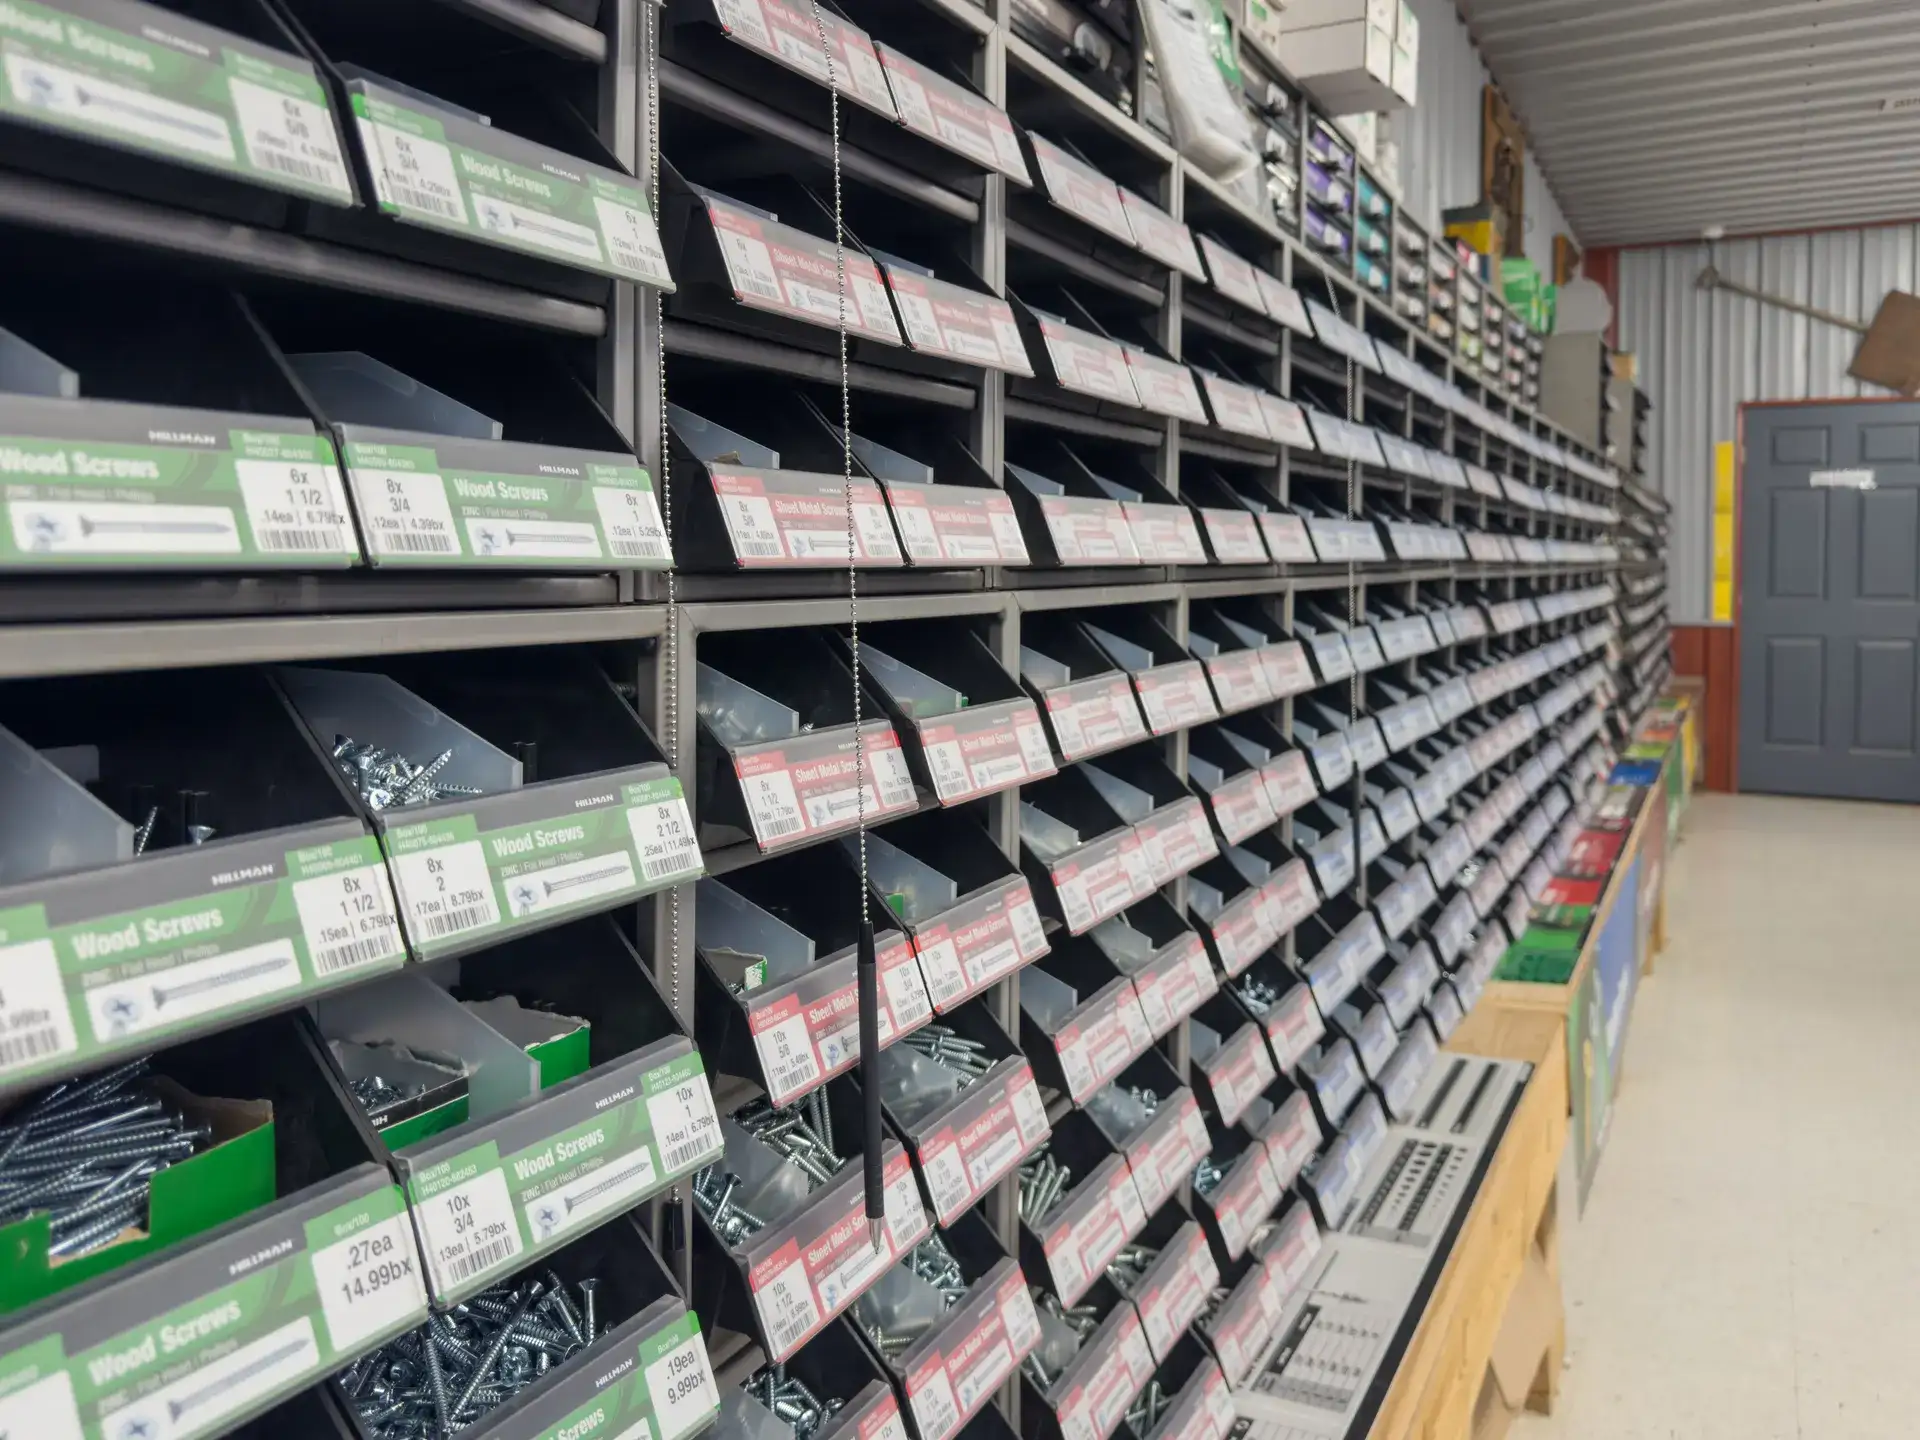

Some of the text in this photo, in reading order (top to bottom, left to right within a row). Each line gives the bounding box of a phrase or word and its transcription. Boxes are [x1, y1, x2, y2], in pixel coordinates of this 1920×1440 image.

[459, 153, 502, 182] Wood
[501, 168, 553, 198] Screws
[71, 449, 160, 481] Screws
[538, 463, 580, 477] HILLMAN
[385, 478, 404, 495] 8x
[453, 477, 550, 503] Wood Screws
[389, 496, 411, 513] 3/4
[625, 493, 639, 507] 8x
[818, 762, 841, 781] Metal
[574, 794, 615, 808] HILLMAN
[658, 807, 671, 820] 8x
[657, 821, 681, 838] 2 1/2
[492, 825, 585, 858] Wood Screws
[210, 863, 277, 887] HILLMAN
[427, 858, 445, 874] 8x
[342, 877, 361, 894] 8x
[436, 876, 446, 892] 2
[340, 894, 376, 917] 1 1/2
[450, 890, 485, 908] 8.79bx
[71, 907, 225, 961] Wood Screws
[360, 914, 397, 933] 6.79bx
[809, 1002, 834, 1025] Sheet
[833, 992, 856, 1013] Metal
[772, 1031, 787, 1045] 10x
[778, 1044, 791, 1059] 5/8
[595, 1086, 634, 1110] HILLMAN
[676, 1087, 694, 1103] 10x
[685, 1104, 692, 1118] 1
[665, 1130, 686, 1148] .14ea
[513, 1128, 605, 1181] Wood Screws
[520, 1185, 540, 1202] ZINC
[446, 1195, 471, 1215] 10x
[454, 1211, 475, 1234] 3/4
[473, 1220, 507, 1246] 5.79bx
[347, 1235, 394, 1271] .27ea
[807, 1225, 853, 1267] Sheet Metal
[228, 1239, 294, 1276] HILLMAN
[341, 1256, 414, 1304] 14.99bx
[772, 1281, 787, 1297] 10x
[86, 1332, 157, 1387] Wood
[159, 1299, 243, 1354] Screws
[595, 1358, 634, 1389] HILLMAN
[667, 1350, 695, 1380] .19ea
[667, 1368, 707, 1405] 9.99bx
[556, 1408, 605, 1440] Screws
